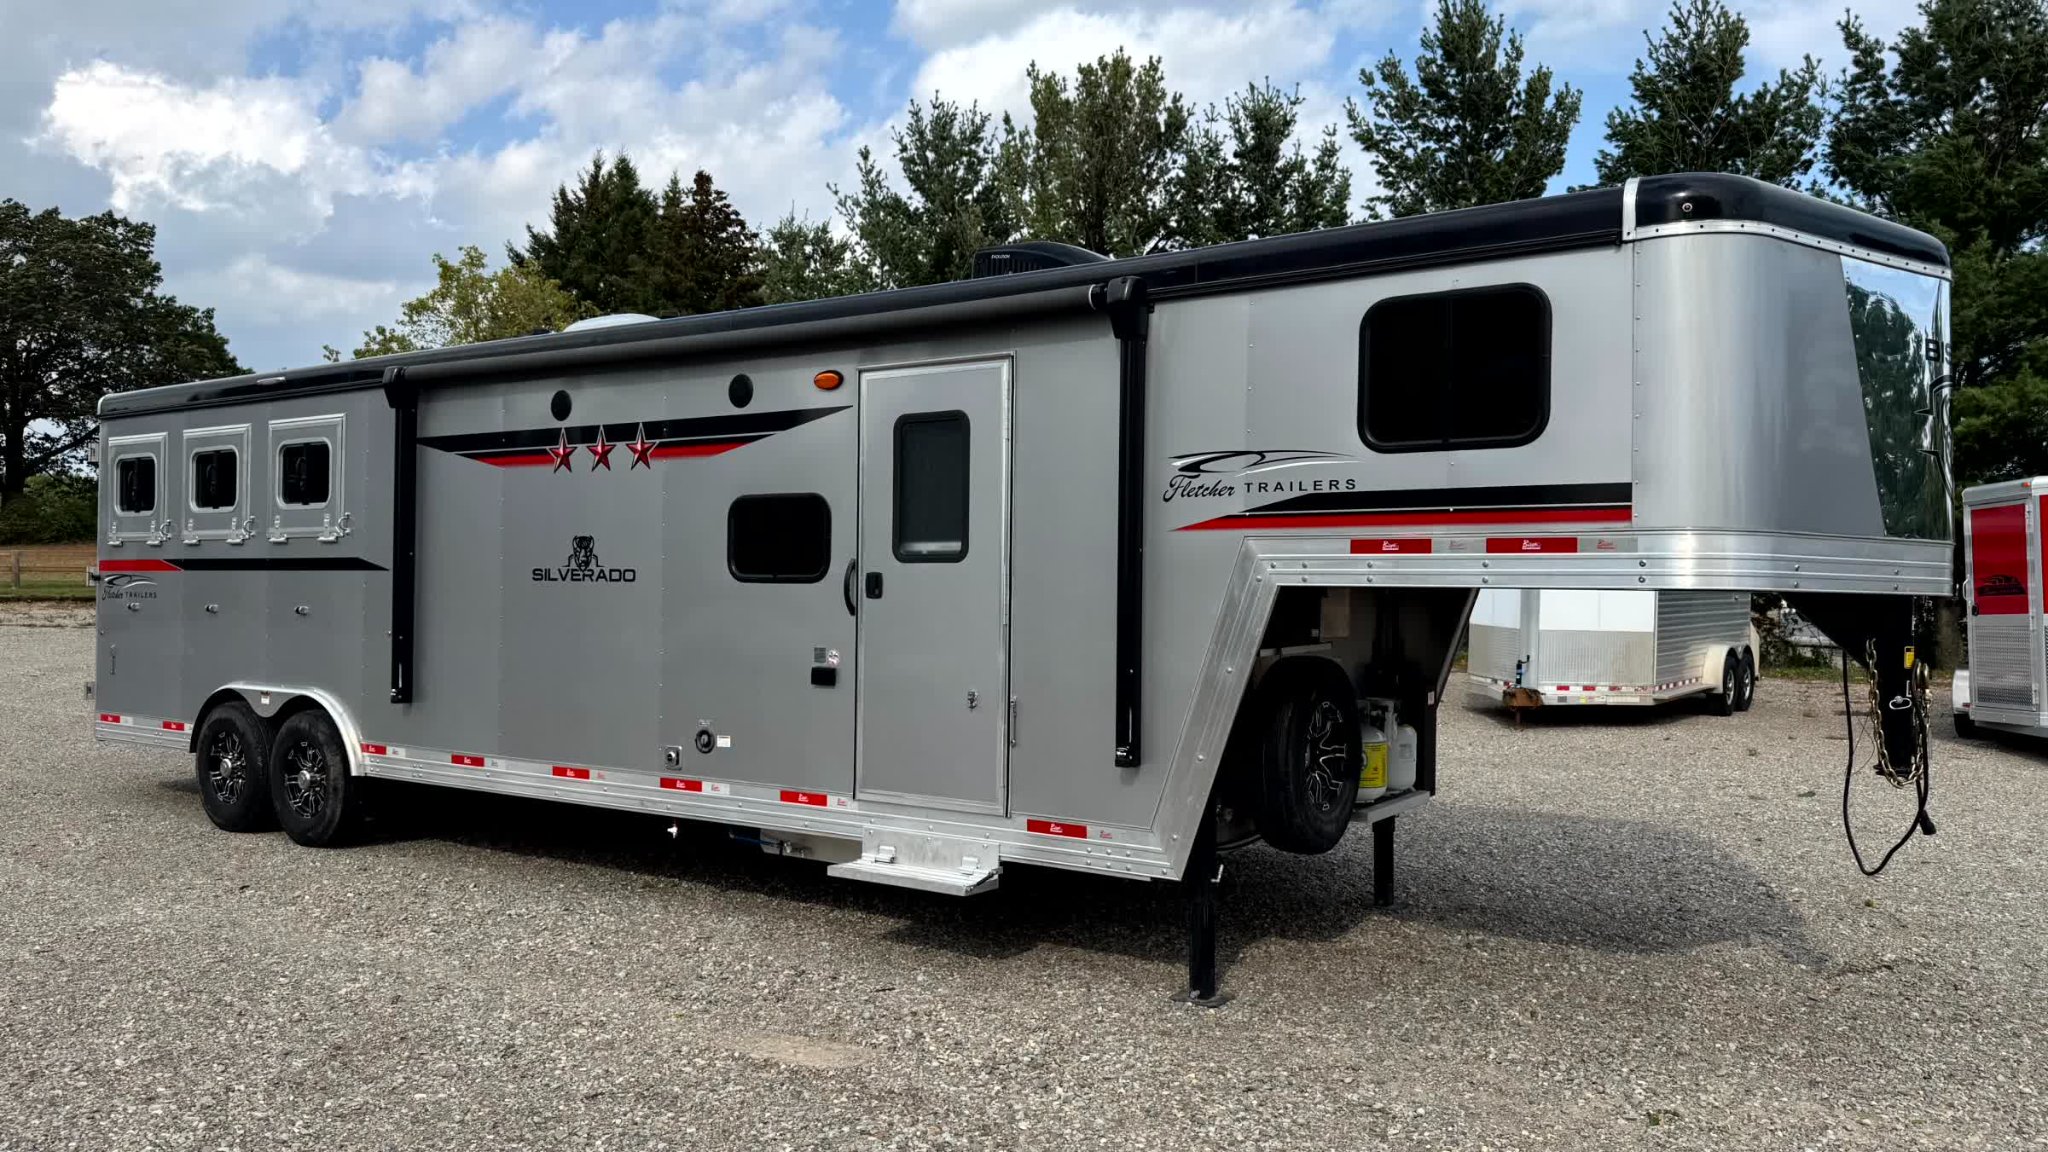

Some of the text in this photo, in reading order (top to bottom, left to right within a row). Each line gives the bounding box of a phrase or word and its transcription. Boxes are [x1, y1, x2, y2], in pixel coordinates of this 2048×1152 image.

[1162, 473, 1357, 503] Fletcher TRAILERS
[531, 568, 637, 583] SILVERADO
[124, 591, 158, 600] TRAILERS
